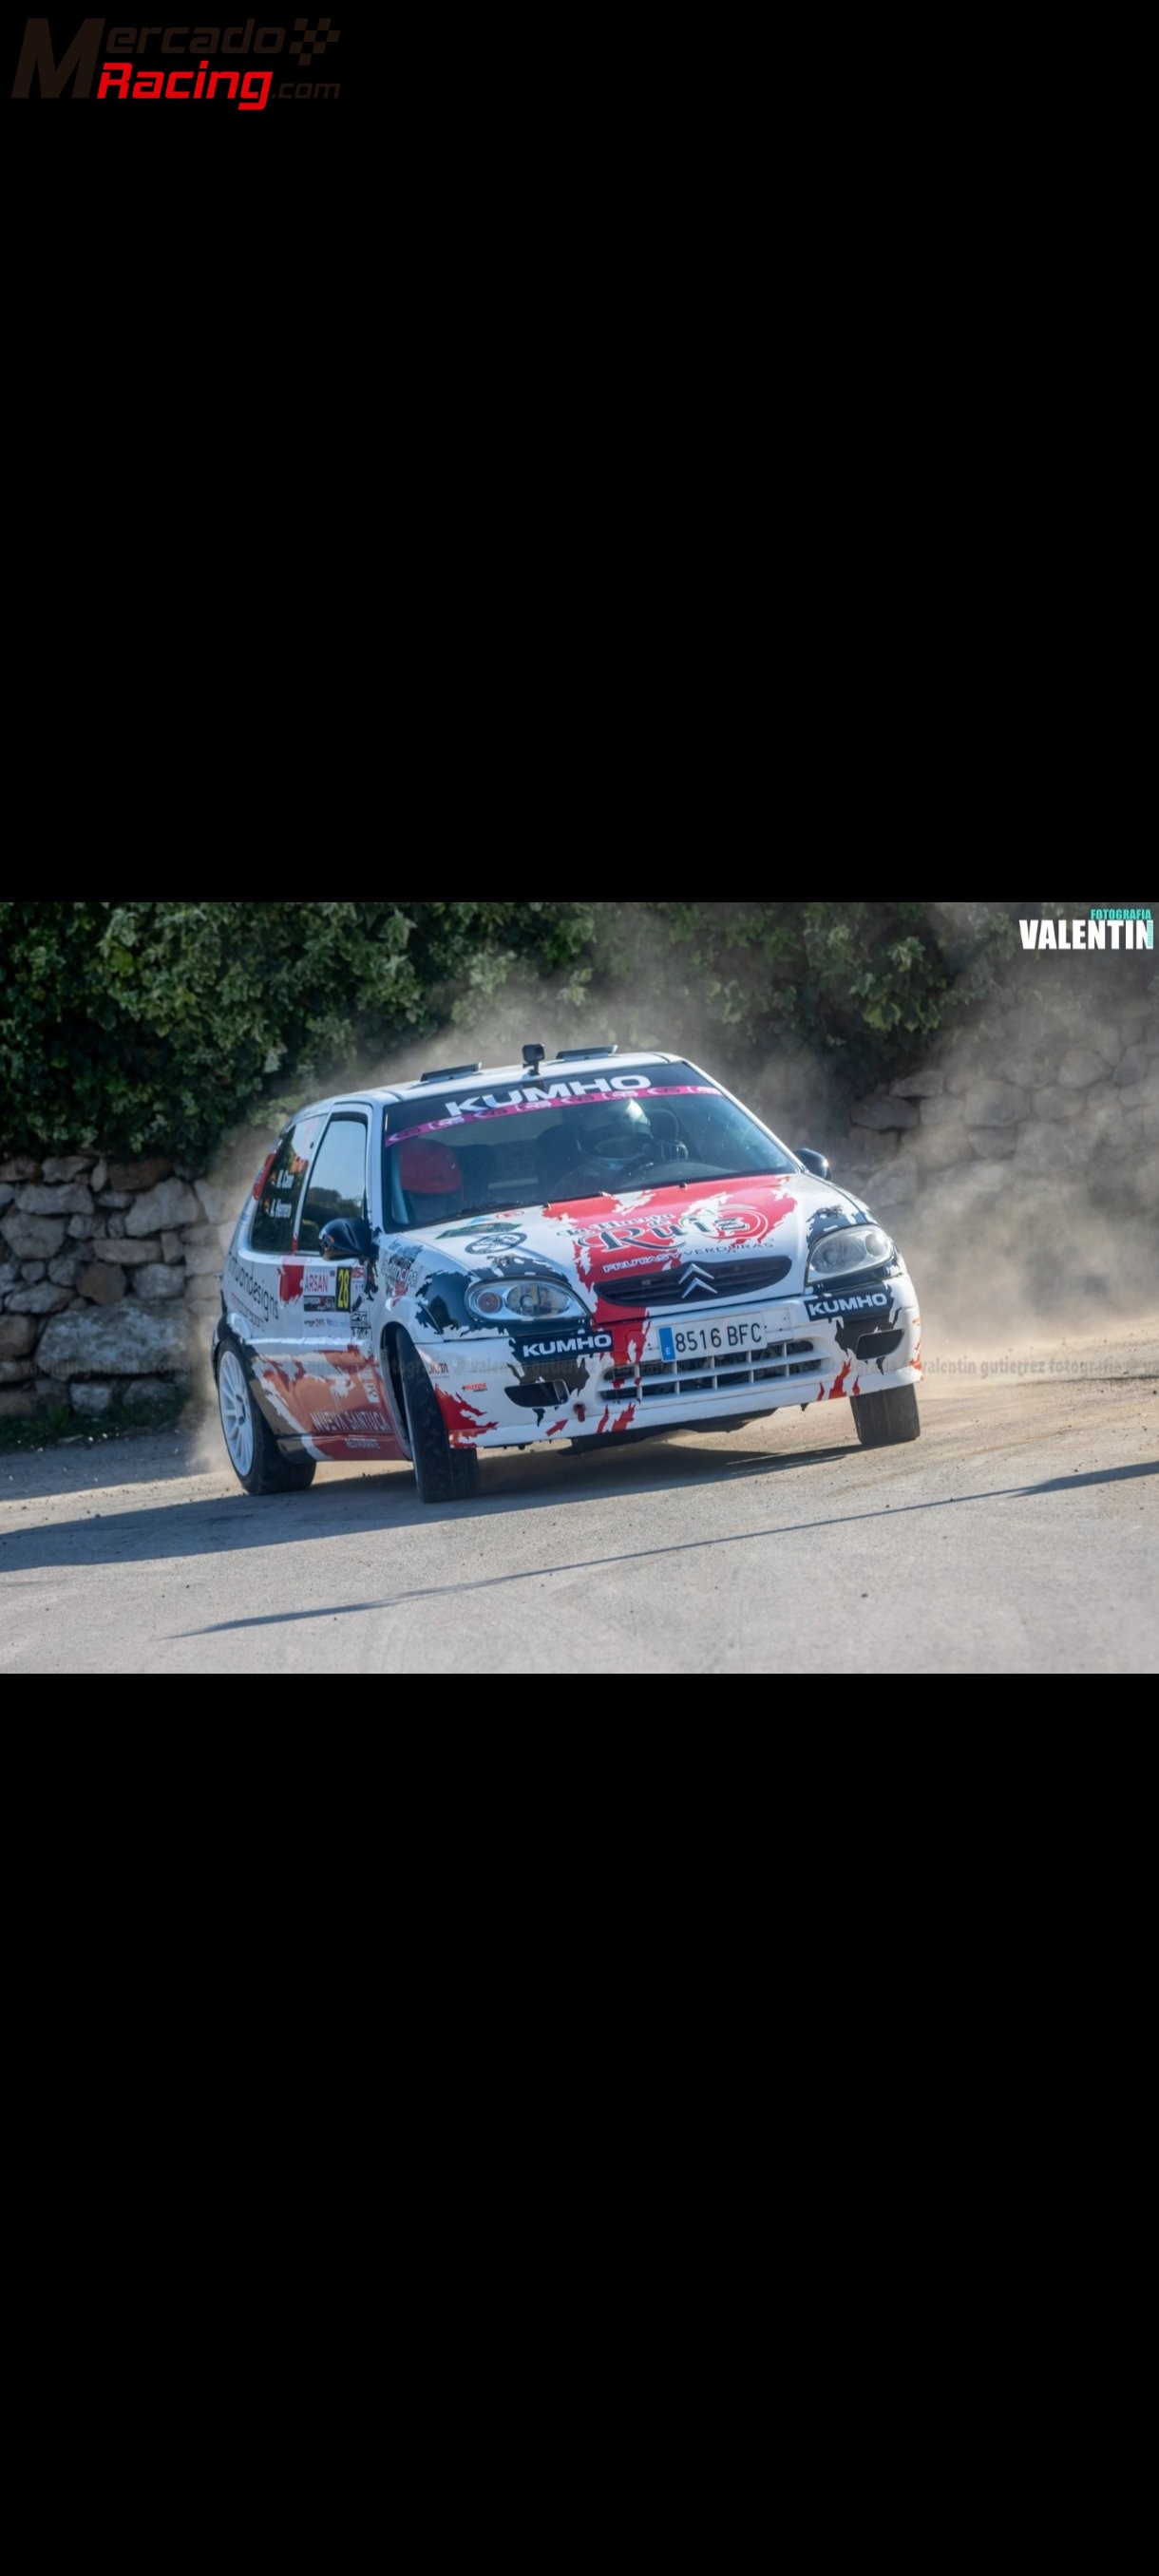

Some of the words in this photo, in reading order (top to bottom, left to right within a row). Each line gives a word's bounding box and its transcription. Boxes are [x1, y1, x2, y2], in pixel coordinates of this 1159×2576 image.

[446, 1074, 651, 1116] KUMHO
[576, 1217, 750, 1253] Ruiz
[603, 1253, 669, 1273] FRUTAS
[686, 1241, 773, 1255] VERDURAS
[304, 1274, 329, 1292] ARSAN
[337, 1268, 350, 1310] 28
[808, 1293, 887, 1316] KUMHO
[522, 1334, 612, 1357] KUMHO
[675, 1327, 722, 1353] 8516
[727, 1322, 762, 1346] BFC
[310, 1411, 349, 1431] NUEVA
